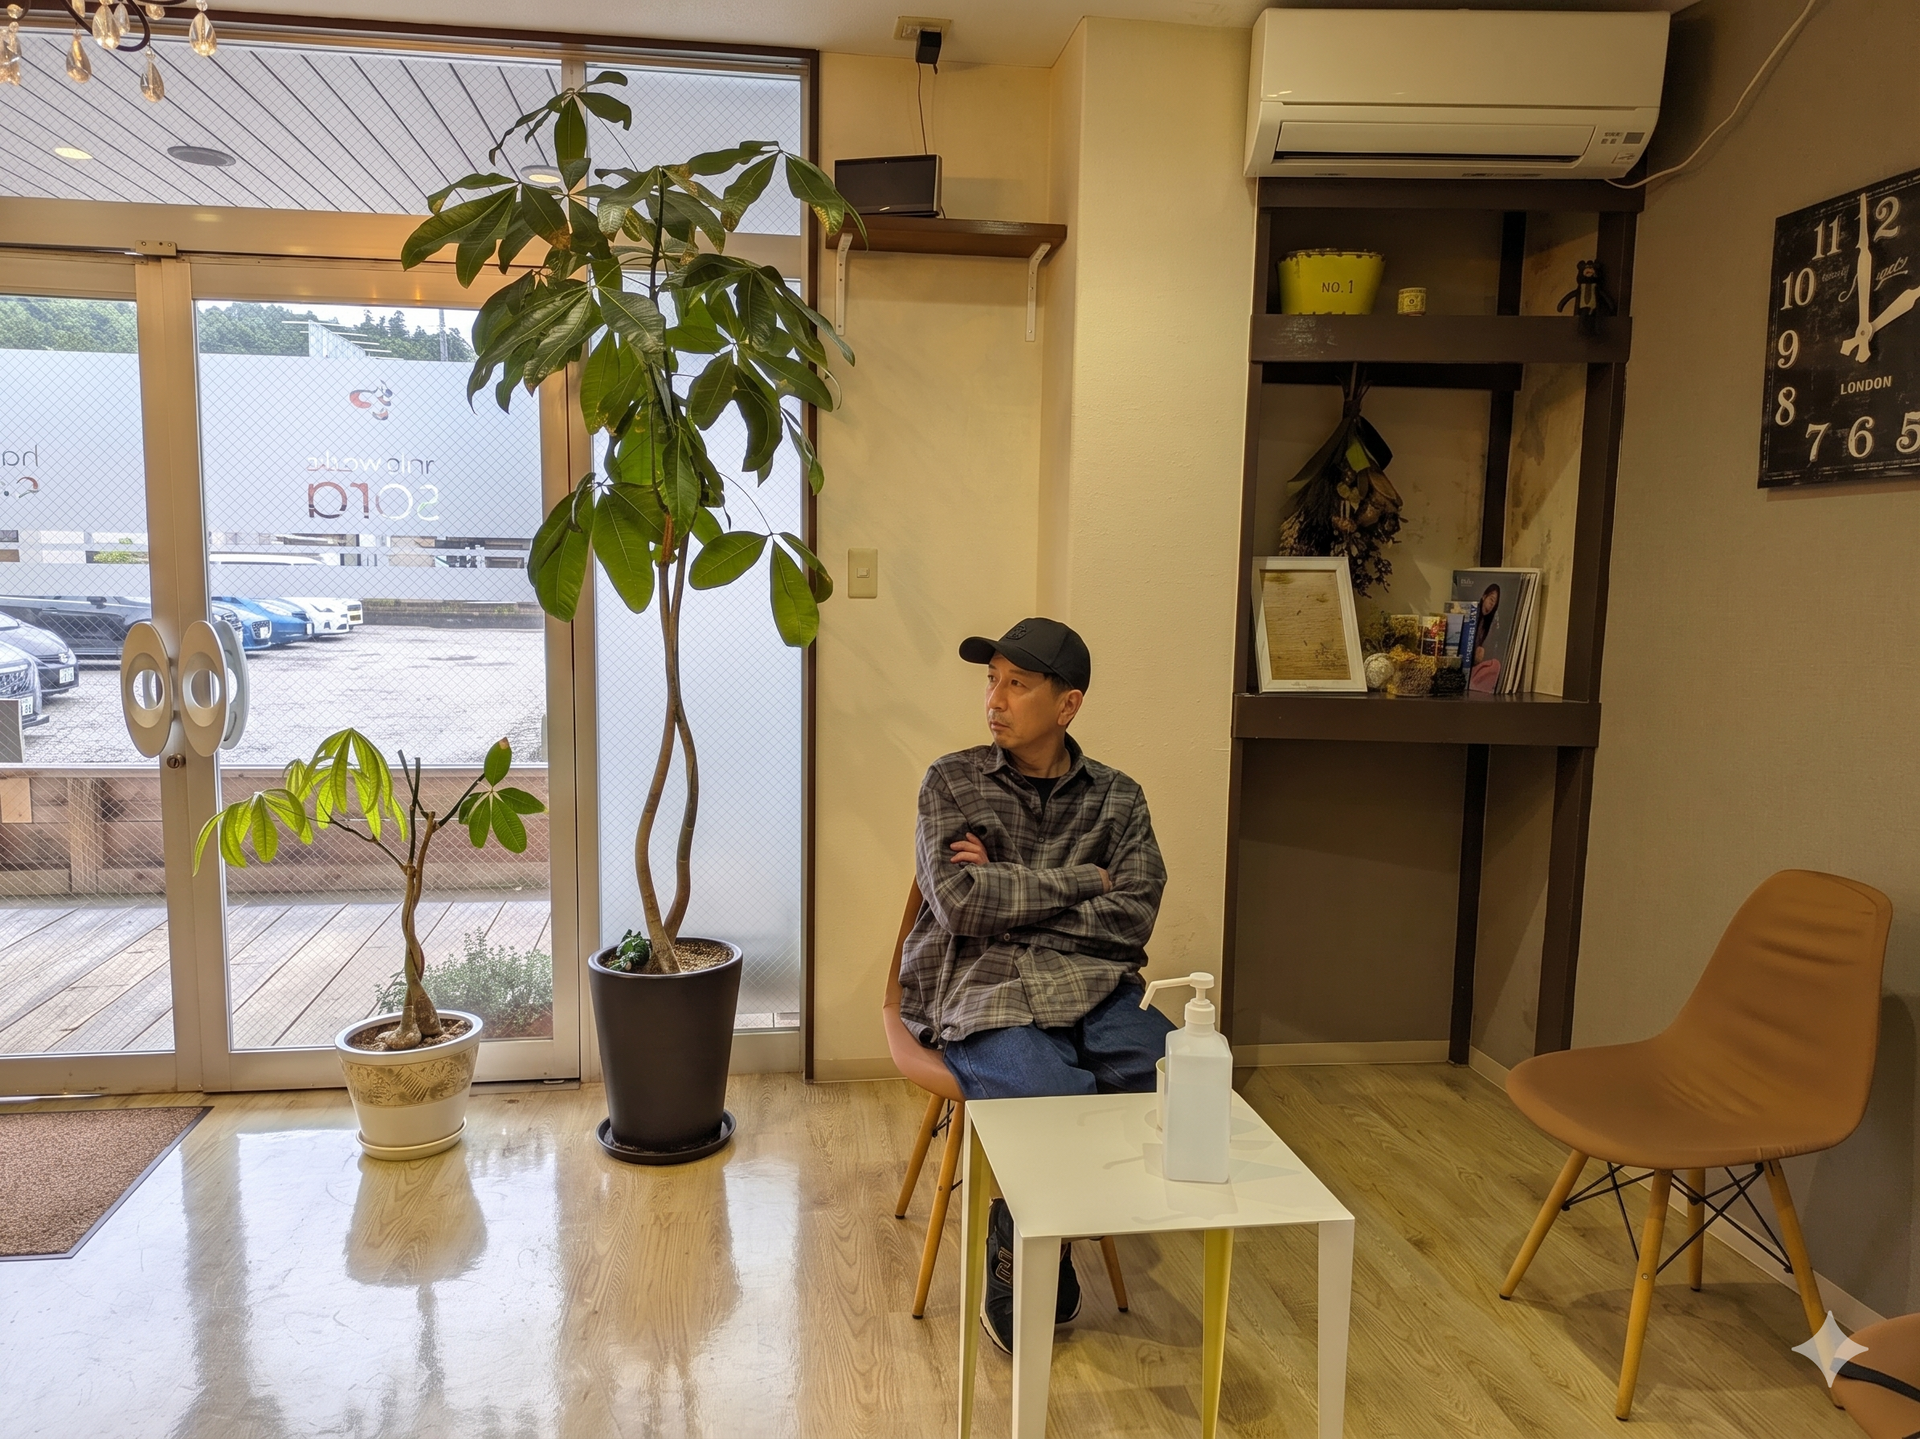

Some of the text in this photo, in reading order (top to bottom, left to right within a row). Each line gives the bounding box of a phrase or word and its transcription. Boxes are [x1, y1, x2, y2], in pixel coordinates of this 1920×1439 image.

[1811, 214, 1843, 261] 11
[1321, 279, 1354, 294] NO. 1
[1780, 267, 1817, 311] 10
[1777, 329, 1799, 369] 9
[1840, 375, 1892, 395] LONDON
[1775, 386, 1797, 427] 8
[1805, 421, 1831, 463] 7
[1847, 416, 1875, 460] 6
[1895, 411, 1920, 454] 5
